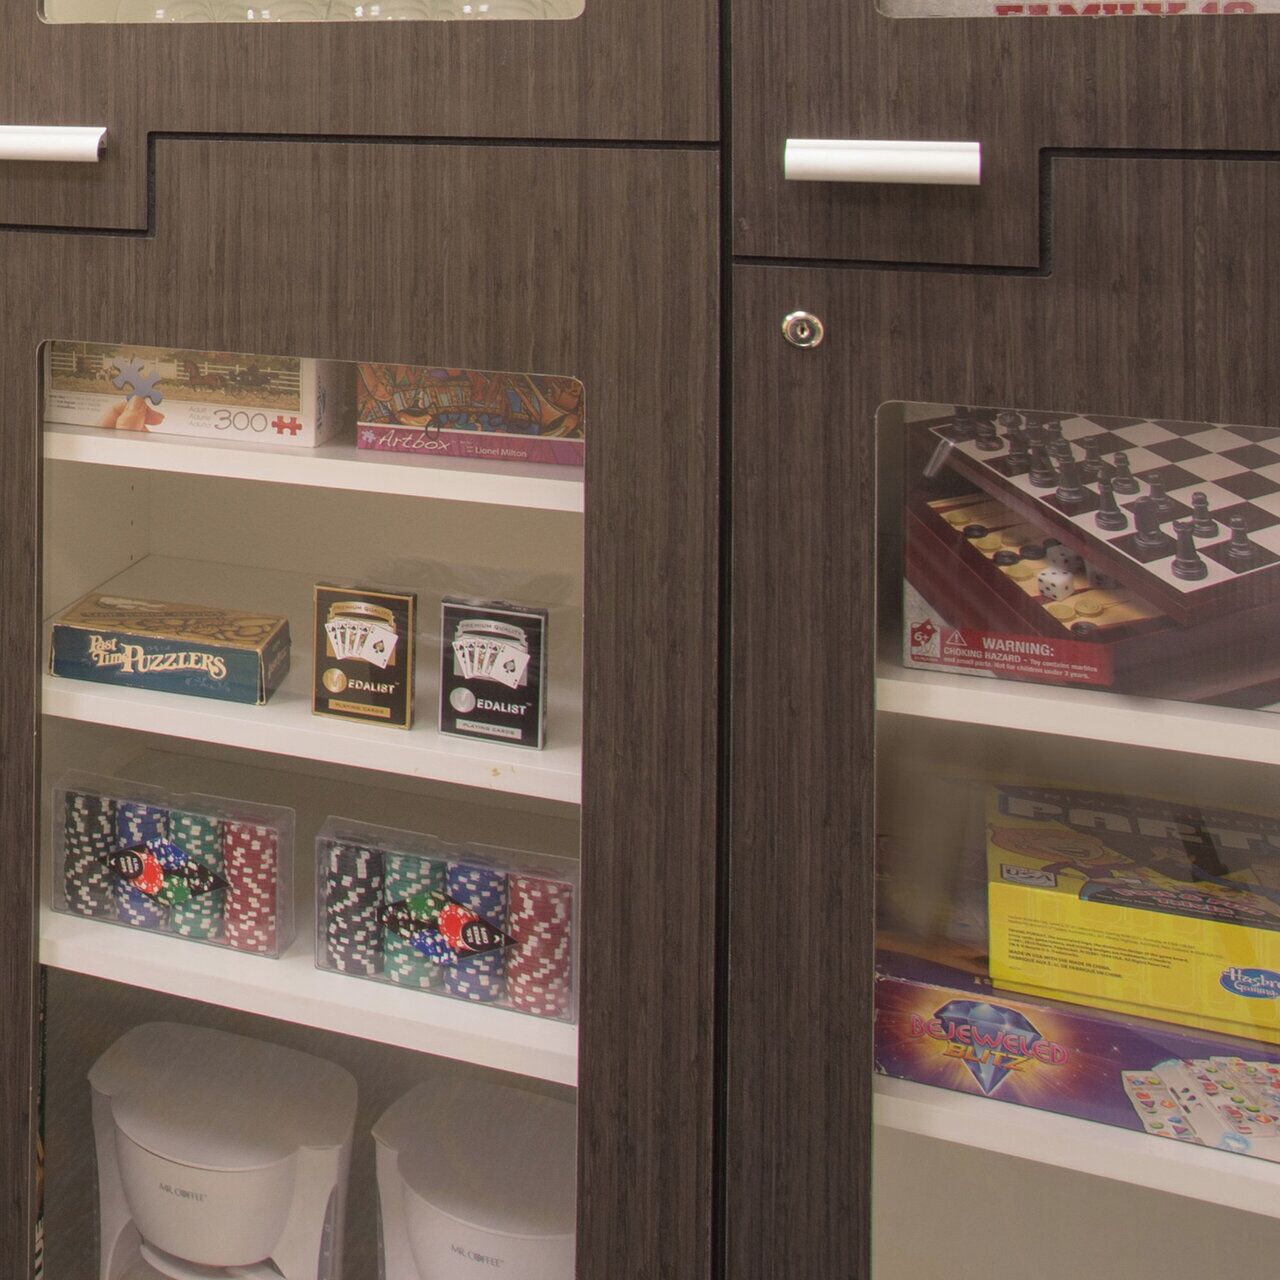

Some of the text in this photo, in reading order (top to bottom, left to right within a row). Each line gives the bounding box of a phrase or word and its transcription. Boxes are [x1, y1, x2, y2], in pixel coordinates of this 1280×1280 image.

[214, 409, 268, 433] 300
[379, 429, 450, 450] Artbox
[475, 446, 499, 456] Lionel
[501, 448, 527, 458] Milton
[90, 635, 117, 653] Past
[914, 631, 929, 642] 6+
[982, 636, 1054, 657] WARNING:
[121, 643, 227, 680] PUZZLERS
[943, 646, 983, 659] CHOKING
[984, 652, 1021, 663] HAZARD
[1030, 658, 1041, 667] Toy
[910, 1014, 1069, 1065] BEJEWELED
[942, 1041, 1033, 1073] BLITZ
